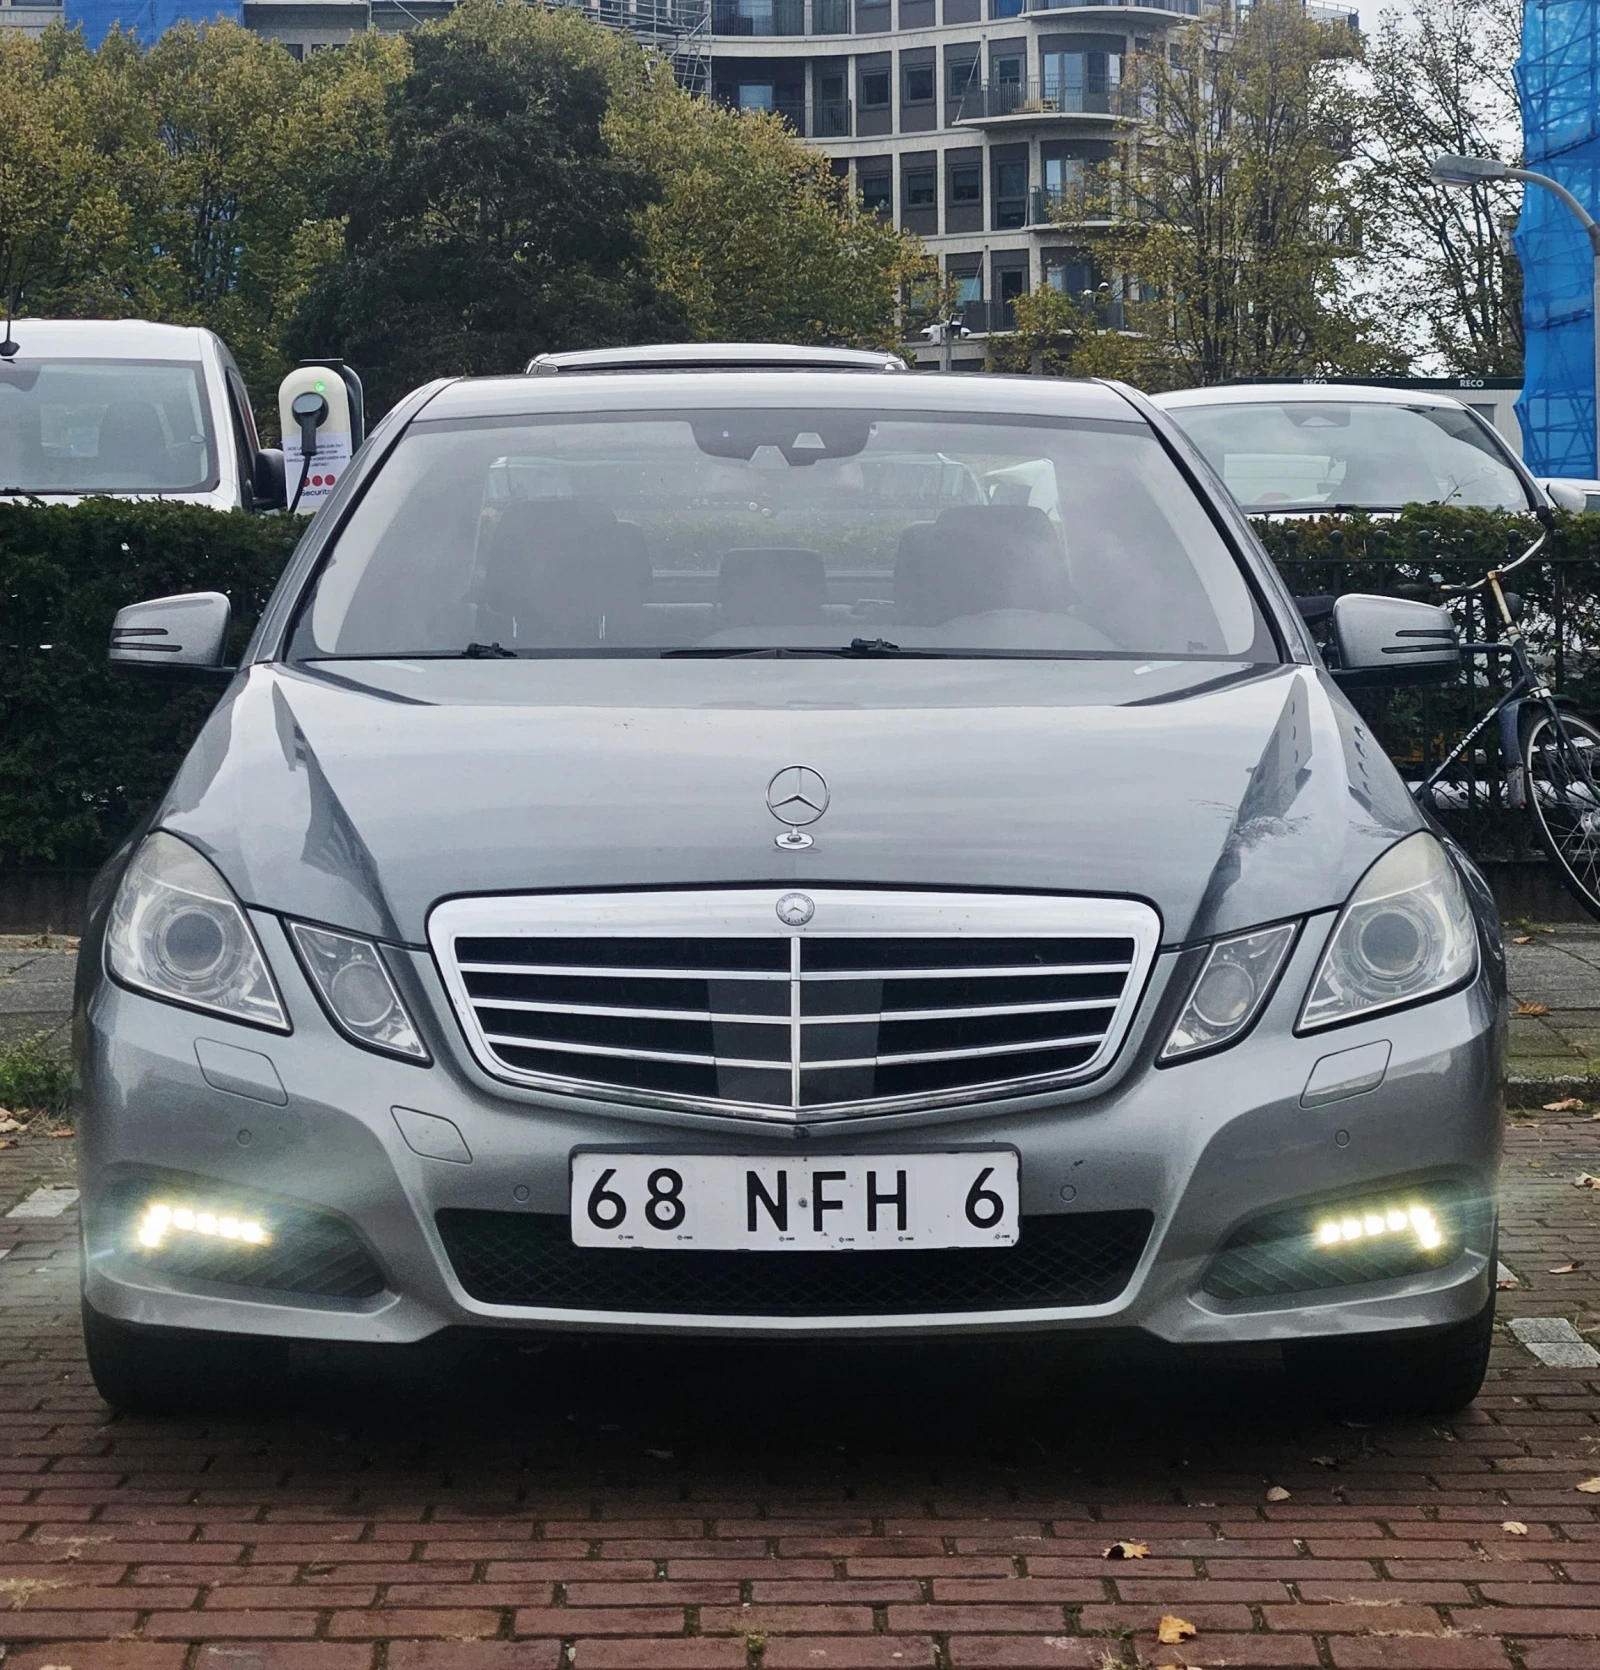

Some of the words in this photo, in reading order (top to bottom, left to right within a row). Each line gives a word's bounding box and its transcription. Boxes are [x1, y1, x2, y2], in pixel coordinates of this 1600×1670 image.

[1460, 379, 1485, 388] RECO
[301, 488, 331, 497] Securit
[588, 1168, 686, 1231] 68
[746, 1170, 907, 1232] NFH
[965, 1167, 1004, 1229] 6
